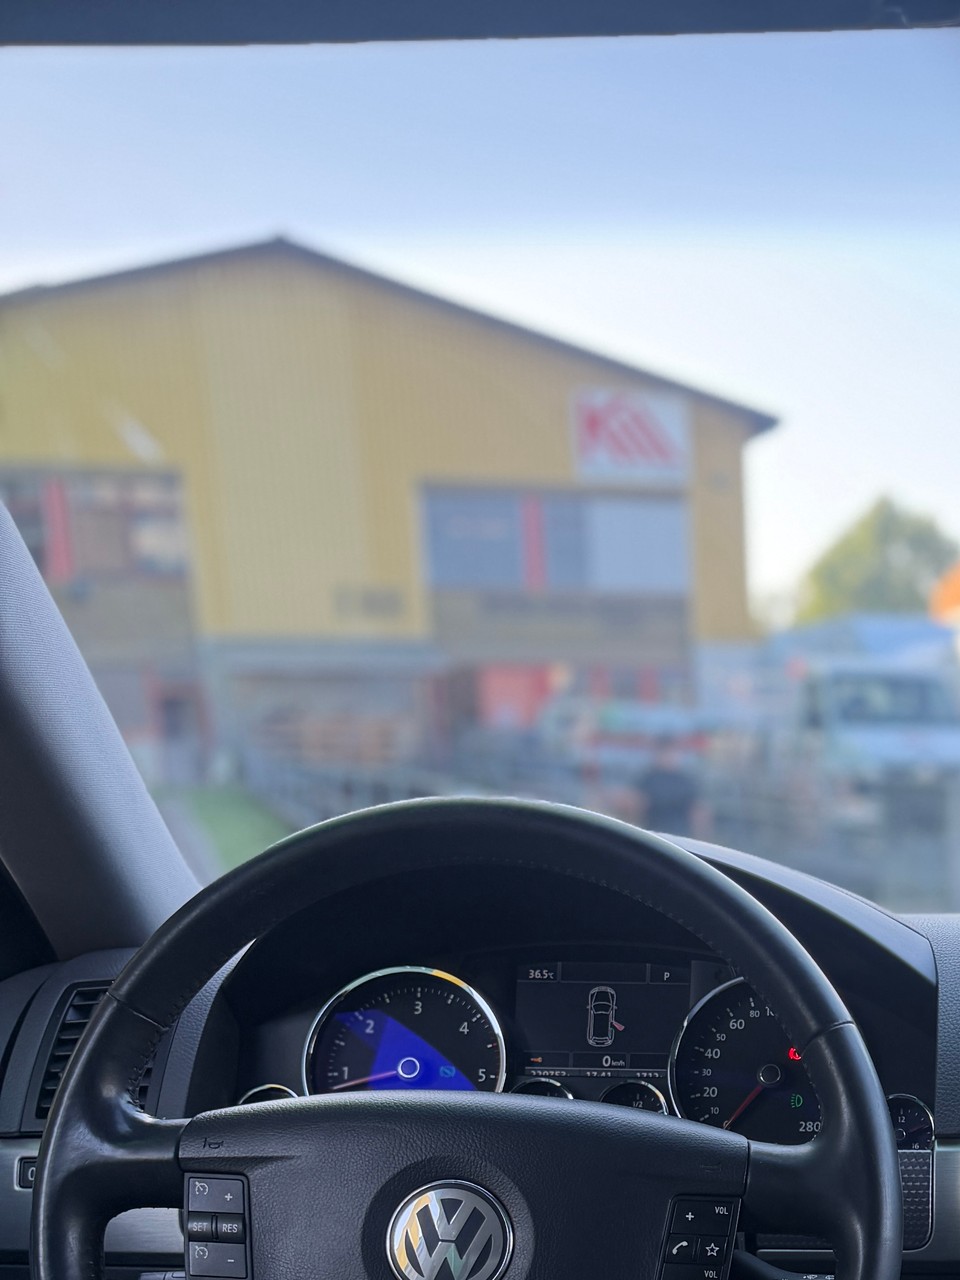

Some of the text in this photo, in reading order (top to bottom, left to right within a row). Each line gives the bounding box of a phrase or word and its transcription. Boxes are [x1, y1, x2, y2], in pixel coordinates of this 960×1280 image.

[664, 971, 670, 981] P
[414, 1001, 423, 1015] 3
[749, 1009, 760, 1018] 80
[365, 1020, 374, 1034] 2
[459, 1021, 469, 1035] 4
[729, 1019, 745, 1030] 60
[716, 1033, 727, 1041] 50
[704, 1048, 721, 1059] 40
[602, 1055, 610, 1067] 0
[342, 1066, 349, 1080] 1
[478, 1068, 486, 1082] 5
[702, 1068, 712, 1076] 30
[703, 1086, 718, 1098] 20
[710, 1106, 720, 1114] 10
[799, 1121, 821, 1132] 280
[714, 1205, 729, 1216] VOL
[192, 1222, 208, 1233] SET
[221, 1222, 238, 1234] RES
[704, 1269, 719, 1280] VOL
